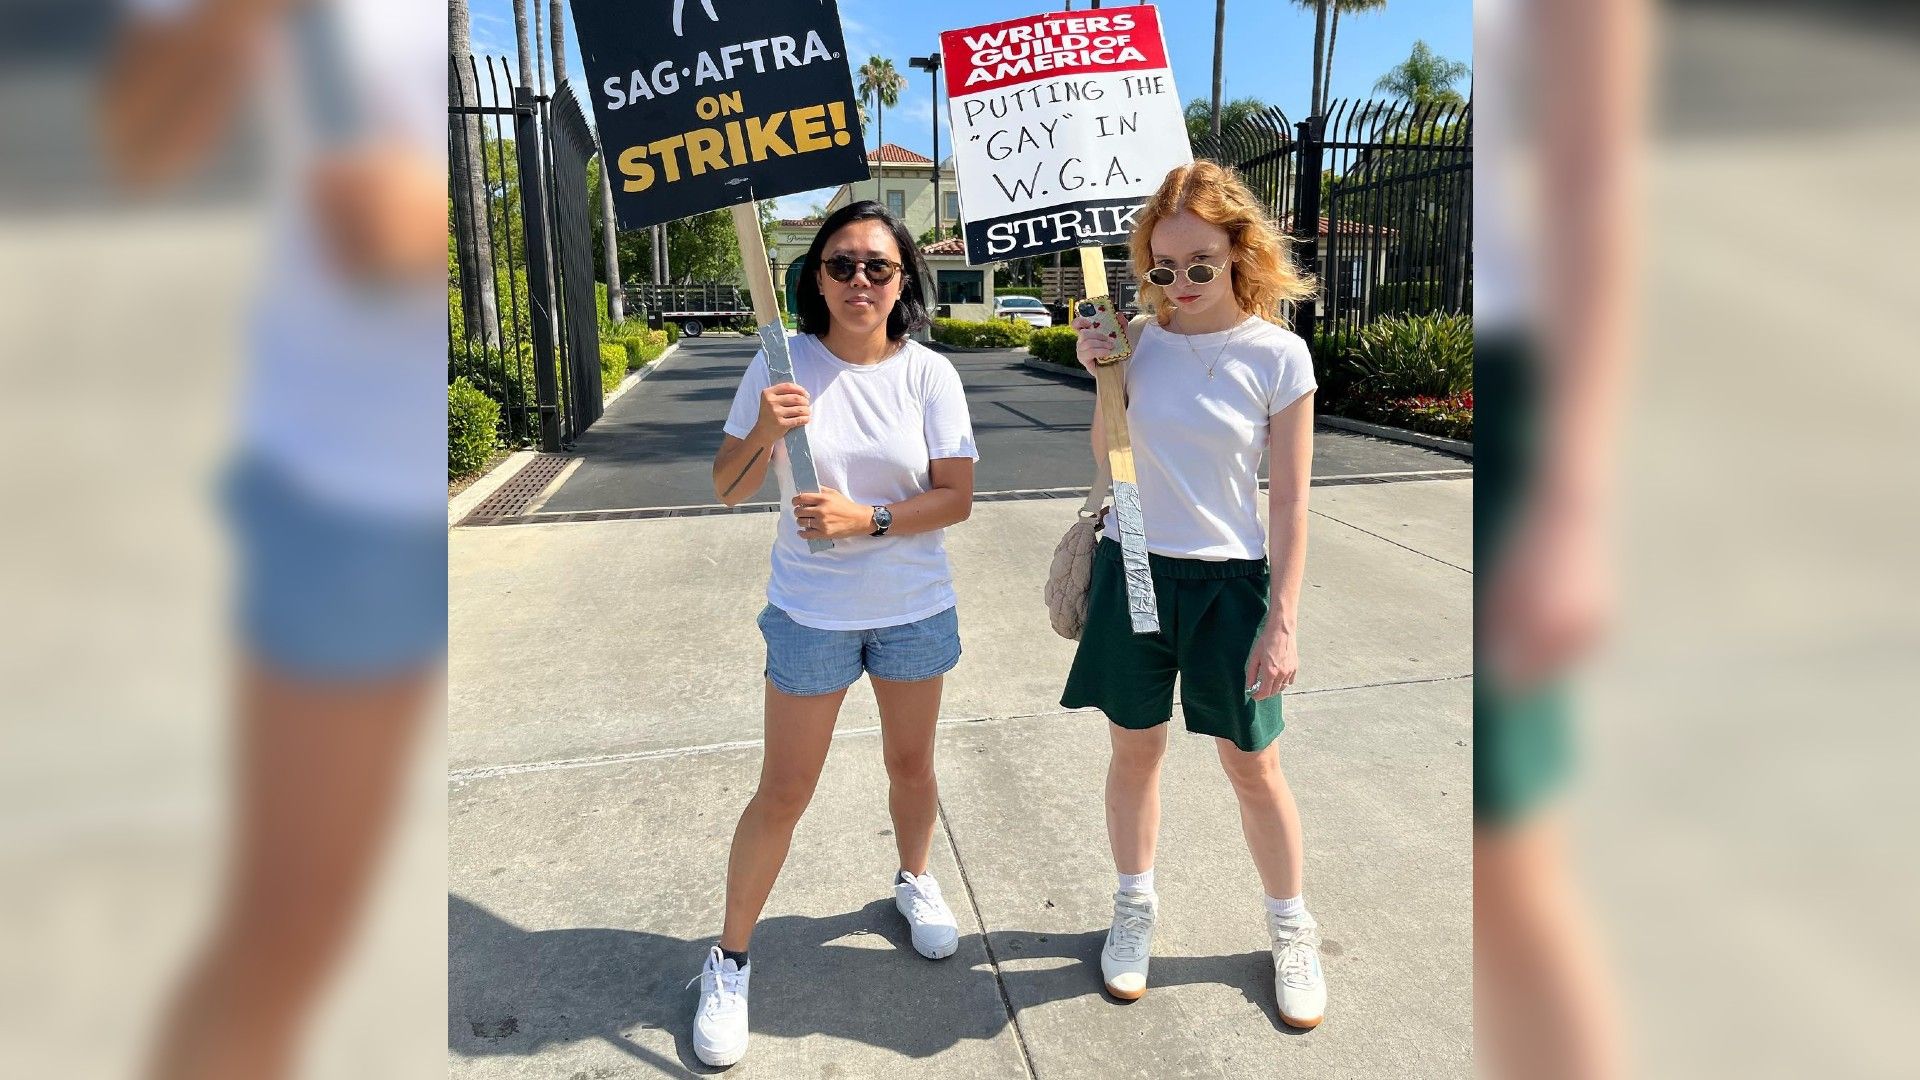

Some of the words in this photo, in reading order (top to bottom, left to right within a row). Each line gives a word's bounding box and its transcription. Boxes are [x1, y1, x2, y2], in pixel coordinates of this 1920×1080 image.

[963, 14, 1136, 52] WRITERS
[970, 34, 1090, 67] GUILD
[1092, 34, 1131, 49] OF
[964, 46, 1148, 87] AMERICA
[695, 90, 744, 121] ON
[963, 80, 1104, 127] PUTTING
[1121, 76, 1166, 99] THE
[617, 101, 851, 193] STRIKE!
[969, 112, 1073, 161] "GAY"
[1095, 111, 1138, 138] IN
[992, 156, 1142, 203] W.G.A.
[986, 203, 1147, 256] STRIK
